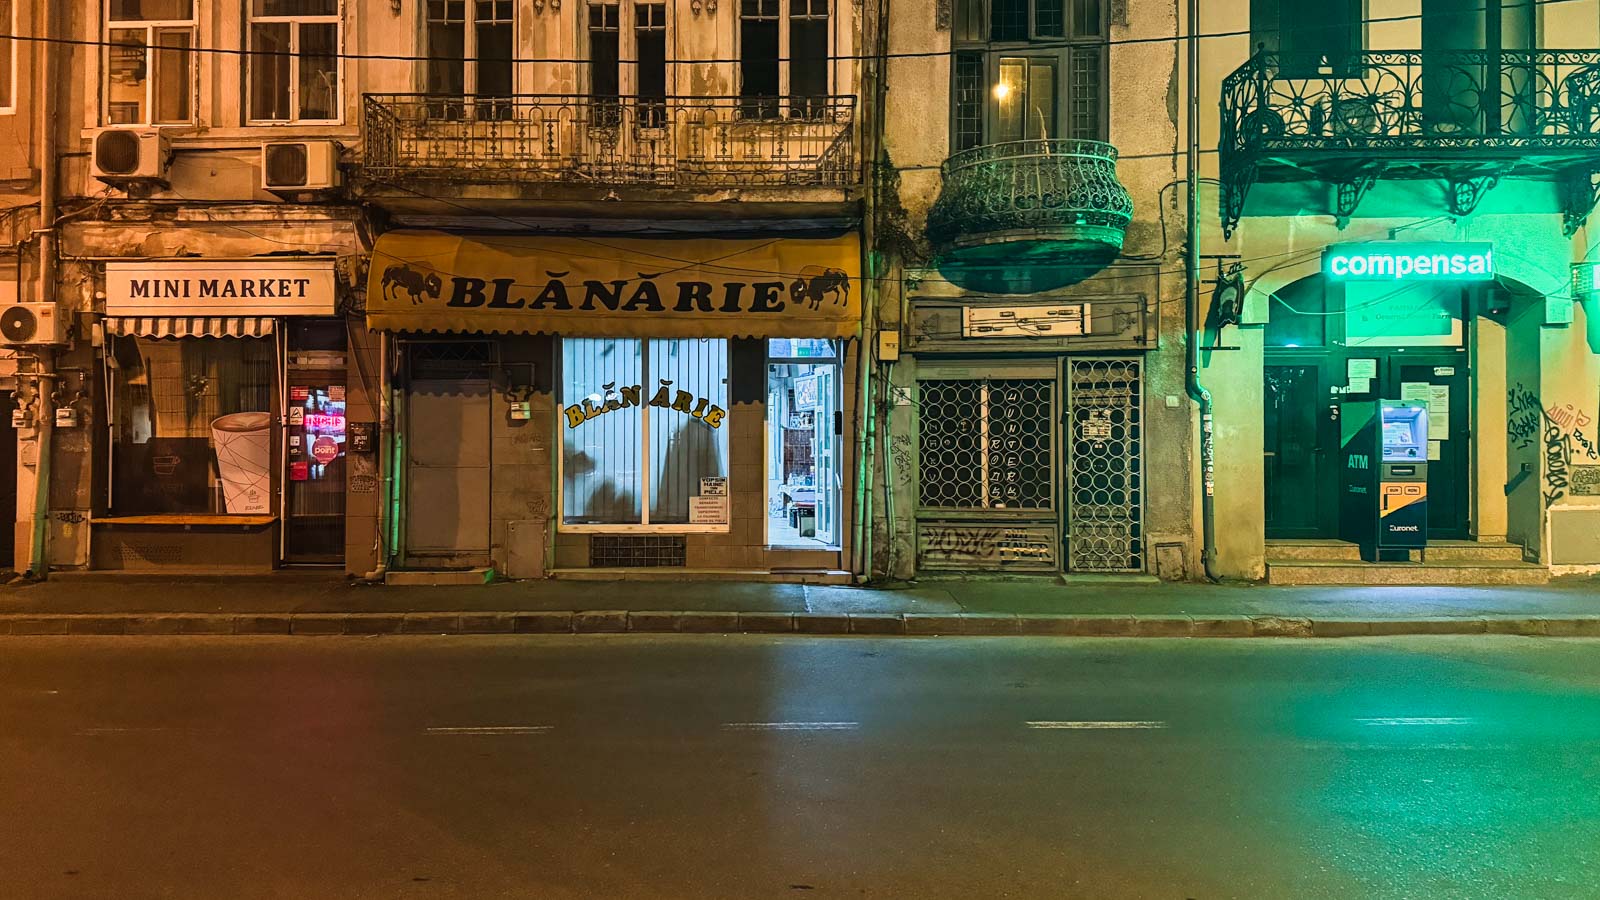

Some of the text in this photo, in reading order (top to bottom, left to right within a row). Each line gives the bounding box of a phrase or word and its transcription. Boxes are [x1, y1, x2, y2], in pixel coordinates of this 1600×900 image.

[130, 279, 310, 298] MINI MARKET
[446, 270, 786, 313] BLĂNĂRIE
[314, 446, 336, 455] point
[1347, 454, 1369, 470] ATM
[1389, 524, 1420, 532] Euronet
